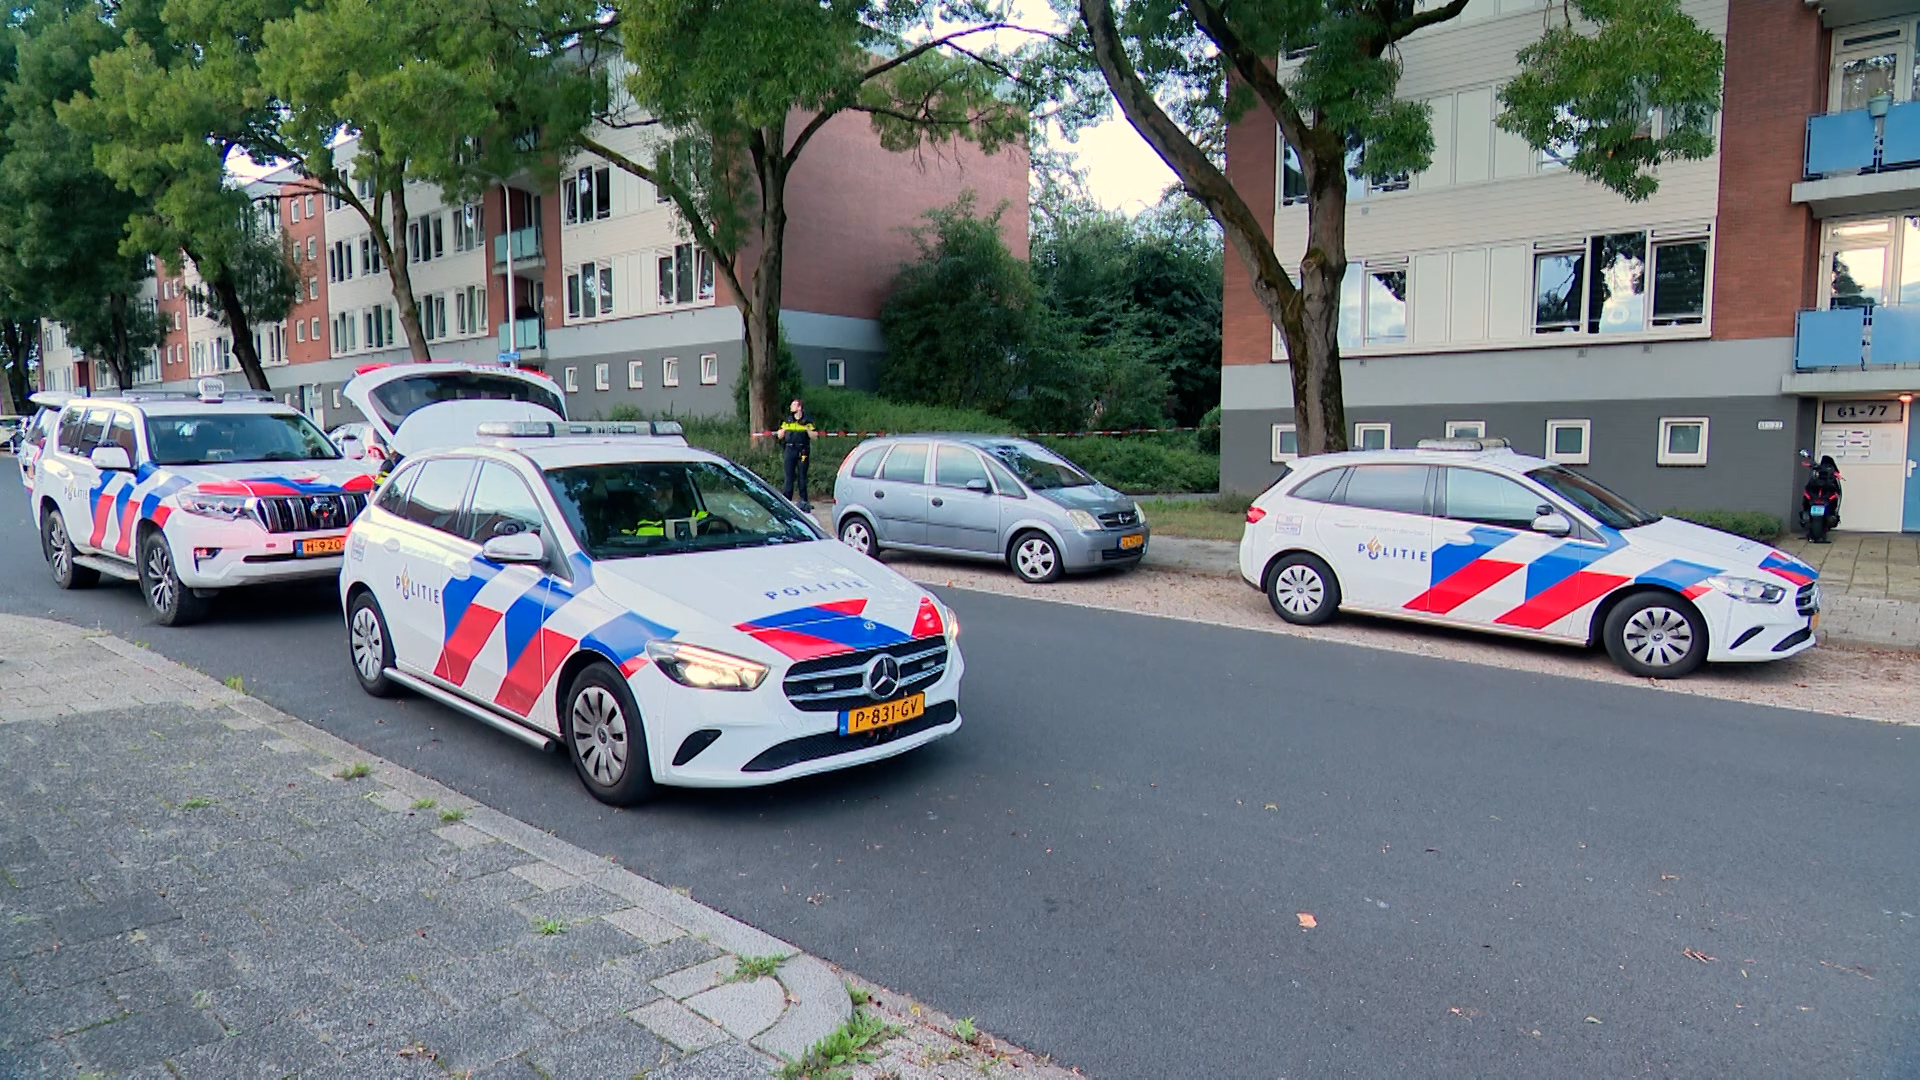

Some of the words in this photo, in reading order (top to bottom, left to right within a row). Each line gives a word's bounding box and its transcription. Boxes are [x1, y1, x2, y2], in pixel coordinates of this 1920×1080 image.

[1837, 404, 1888, 418] 61-77
[1358, 542, 1428, 562] POLITIE
[395, 574, 440, 605] POLITIE
[763, 581, 869, 600] POLITIE
[855, 697, 918, 729] P-831-GV
